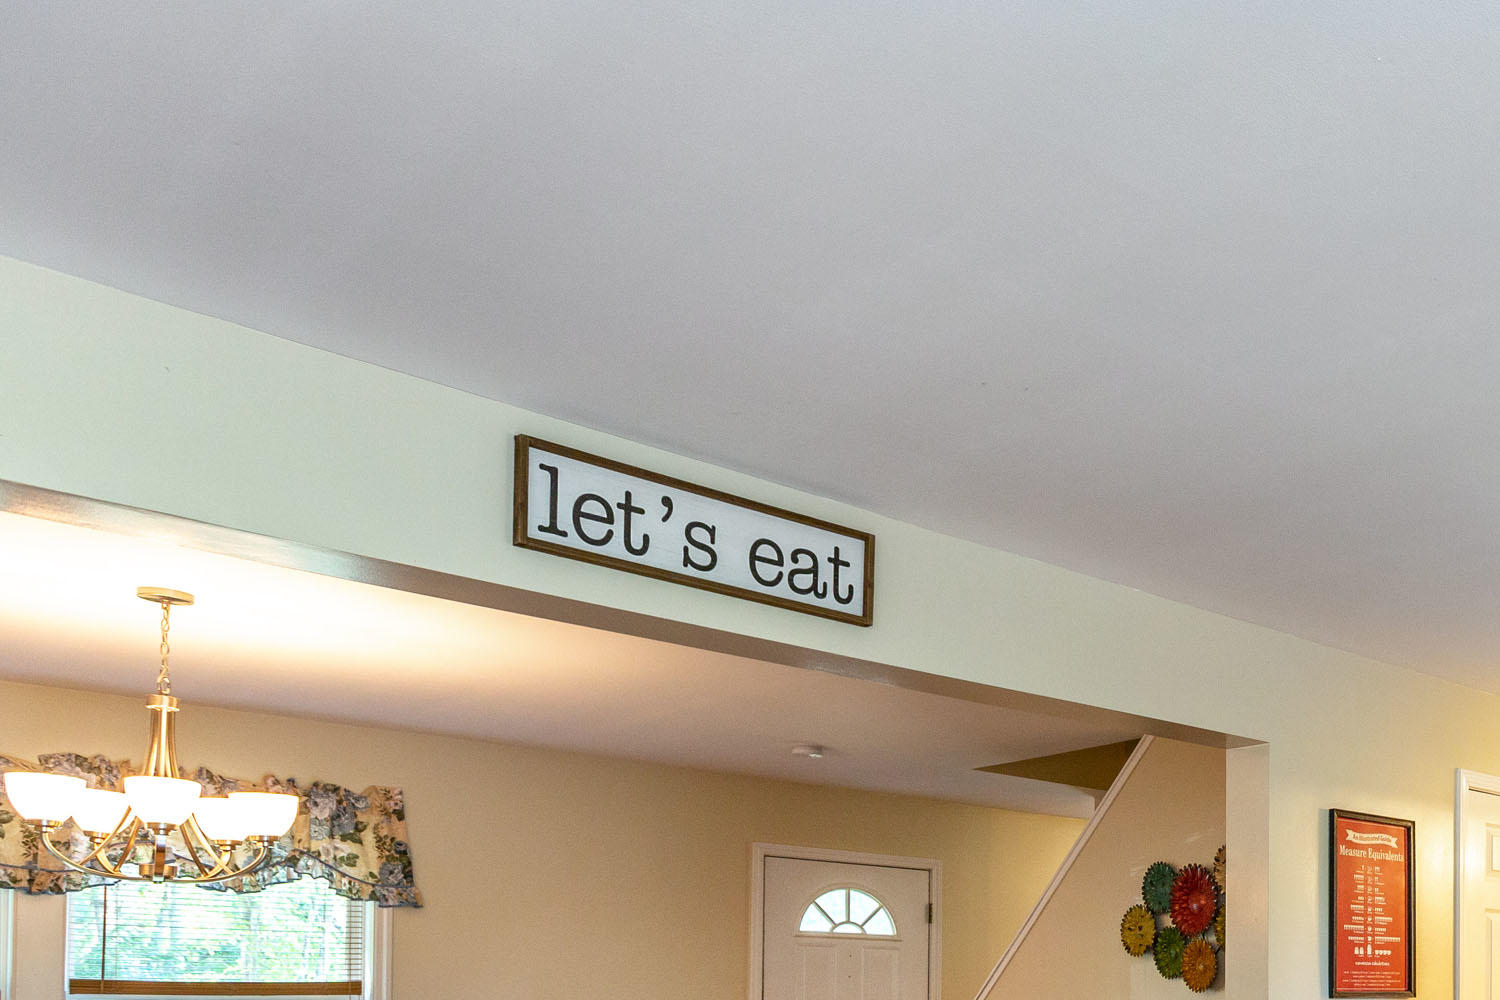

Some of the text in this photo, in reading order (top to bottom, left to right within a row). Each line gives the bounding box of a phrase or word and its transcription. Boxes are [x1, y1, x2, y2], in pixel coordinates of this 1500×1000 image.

[537, 463, 855, 605] let's eat
[1339, 844, 1404, 862] Measure Equivalents
